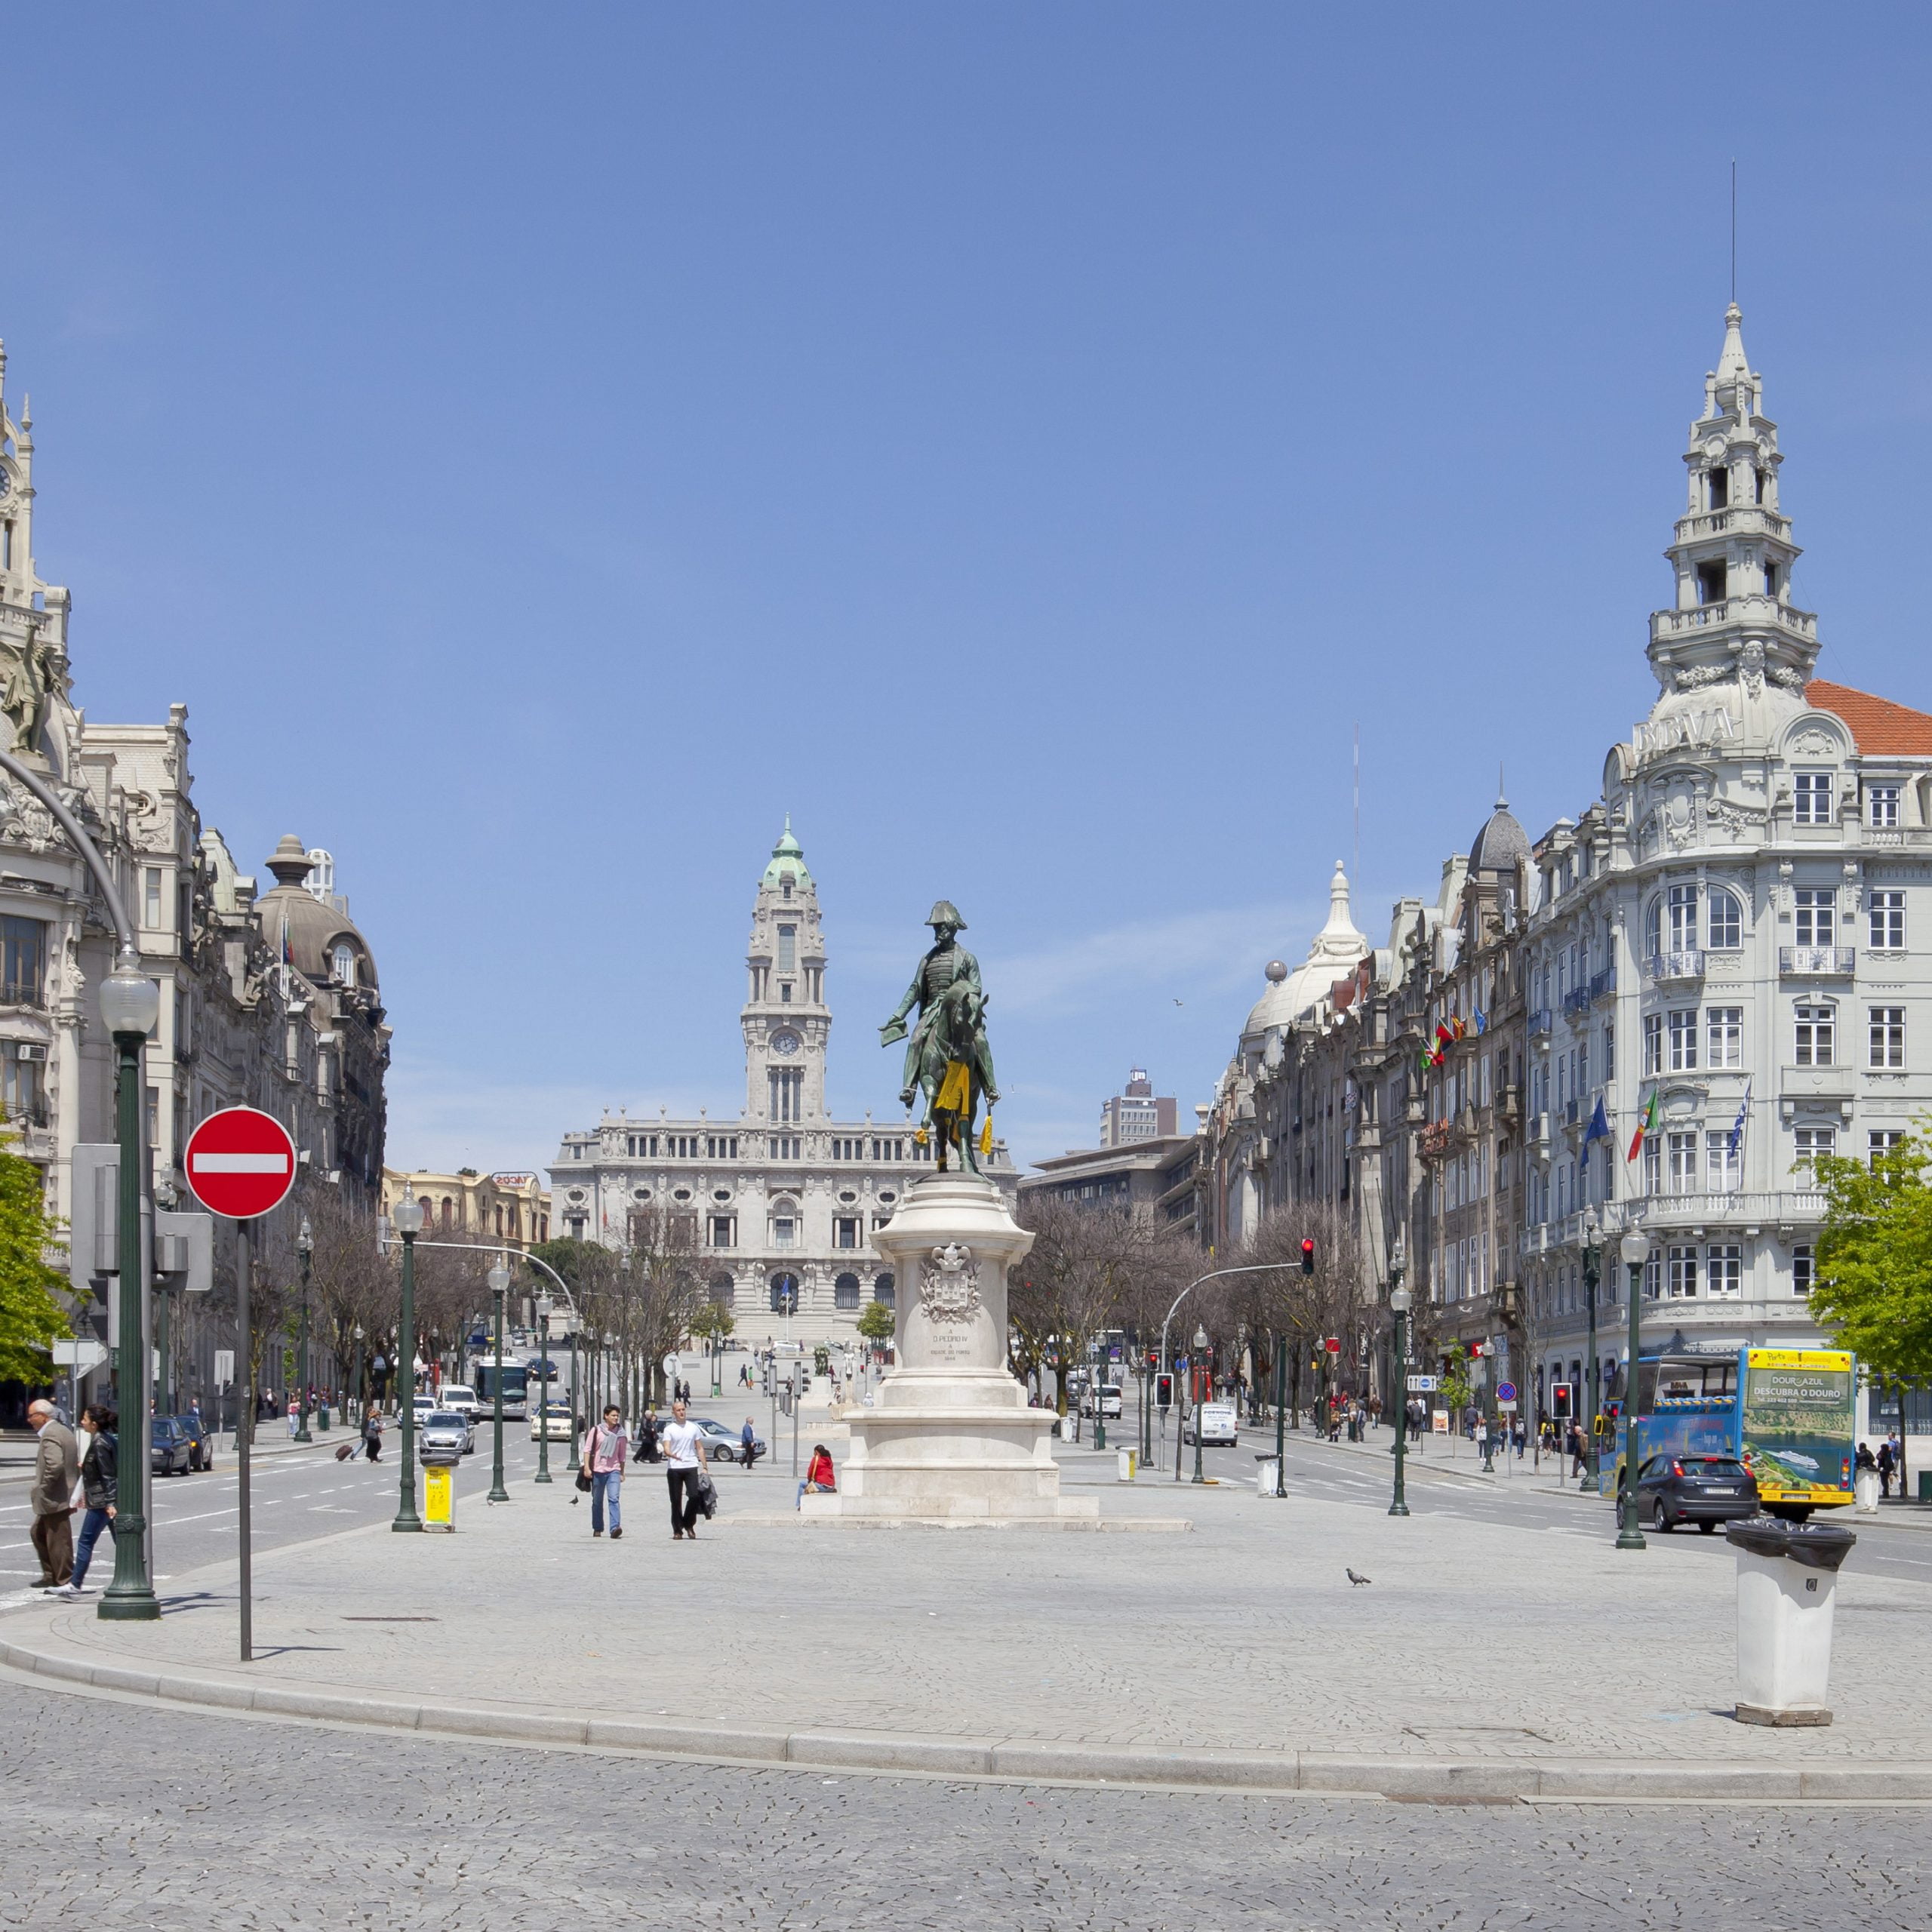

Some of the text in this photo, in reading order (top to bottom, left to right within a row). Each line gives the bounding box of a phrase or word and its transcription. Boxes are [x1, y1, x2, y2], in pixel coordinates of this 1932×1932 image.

[1632, 708, 1734, 755] BBVA
[1754, 1387, 1841, 1398] DESCUBRA O DOURO
